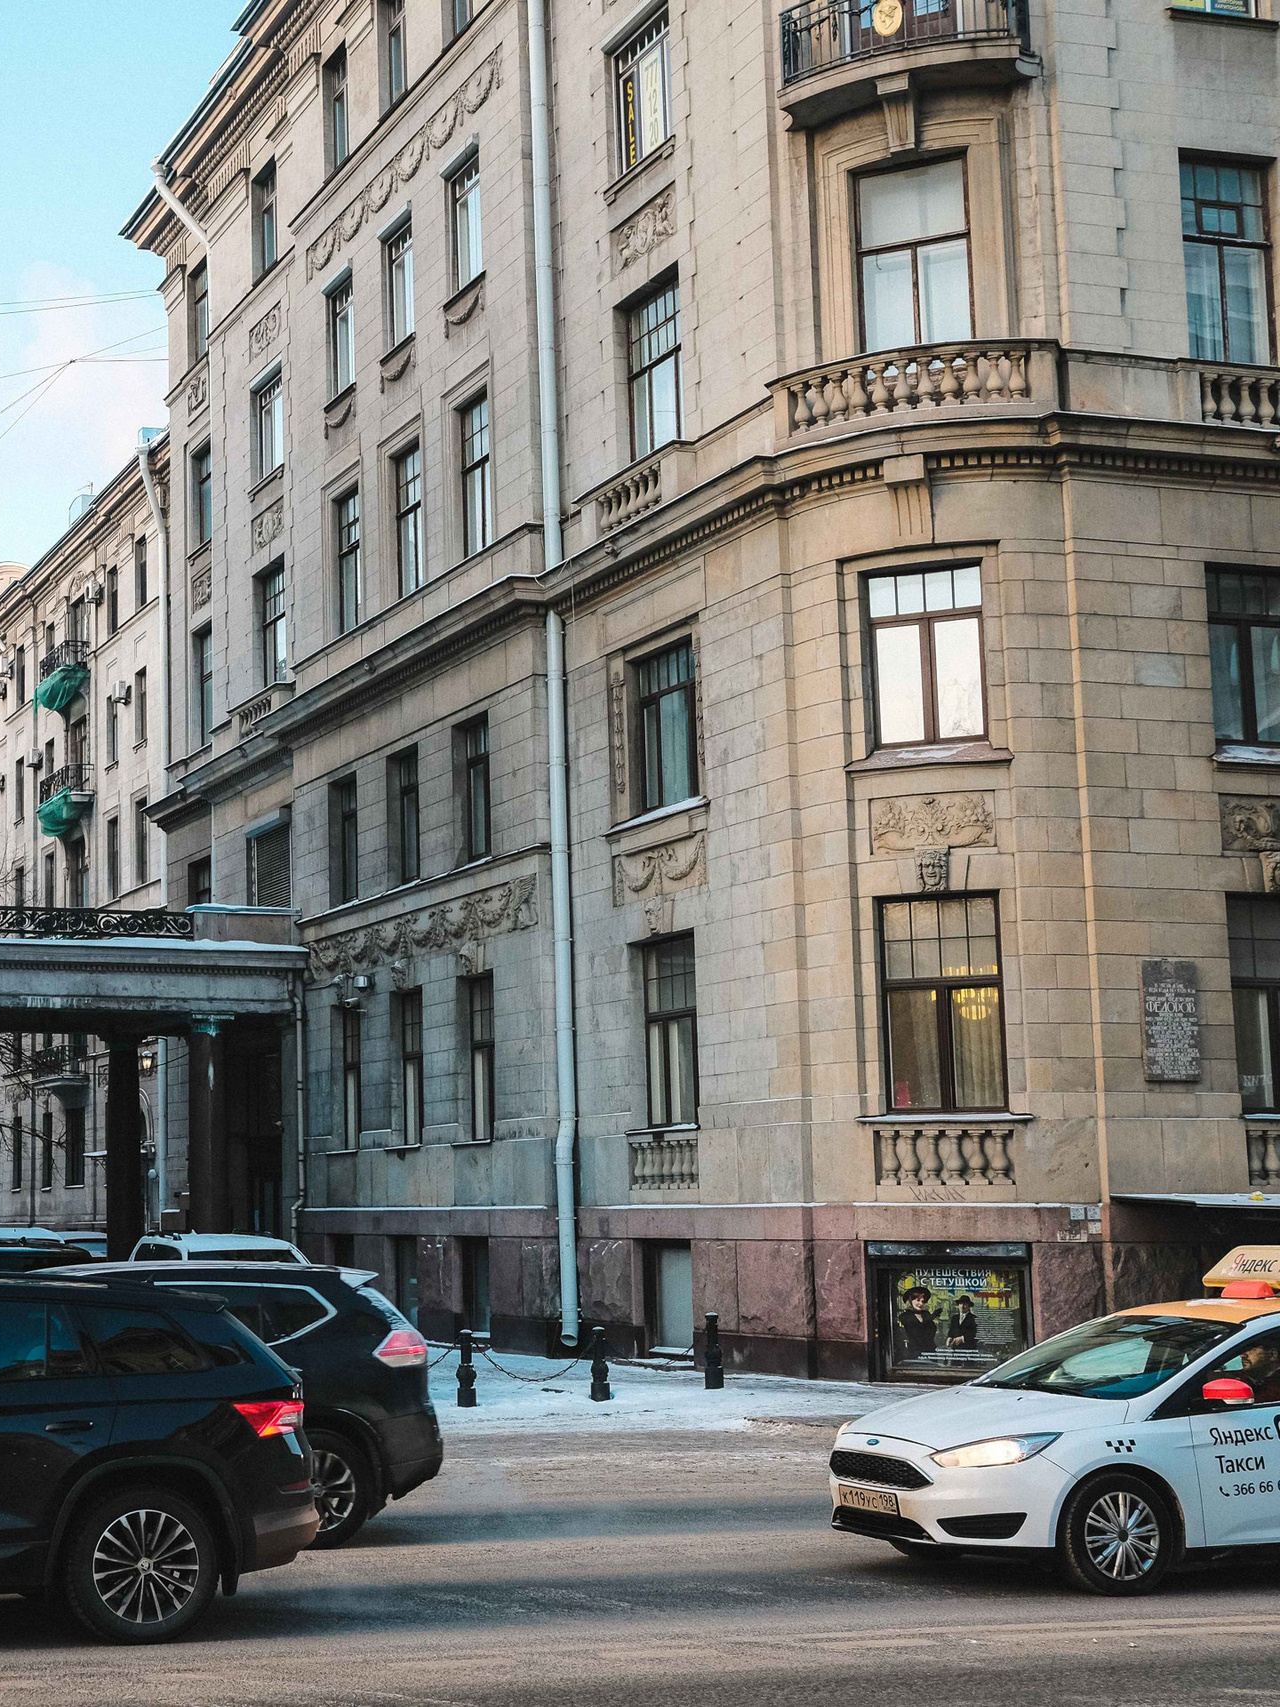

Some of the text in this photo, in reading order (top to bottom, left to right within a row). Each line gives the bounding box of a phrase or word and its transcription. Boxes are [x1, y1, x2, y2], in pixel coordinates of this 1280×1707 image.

[644, 57, 659, 91] 777
[648, 88, 658, 117] 12
[626, 81, 637, 165] SALE
[649, 117, 659, 148] 20
[915, 1268, 992, 1278] ПУТЕШЕСТВИЯ
[1230, 1253, 1278, 1274] Яндекс
[920, 1277, 988, 1287] С ТЕТУШКОЙ
[1209, 1426, 1274, 1447] Яндекс
[1214, 1455, 1266, 1474] Такси
[1232, 1482, 1256, 1497] 366
[1259, 1480, 1274, 1493] 66
